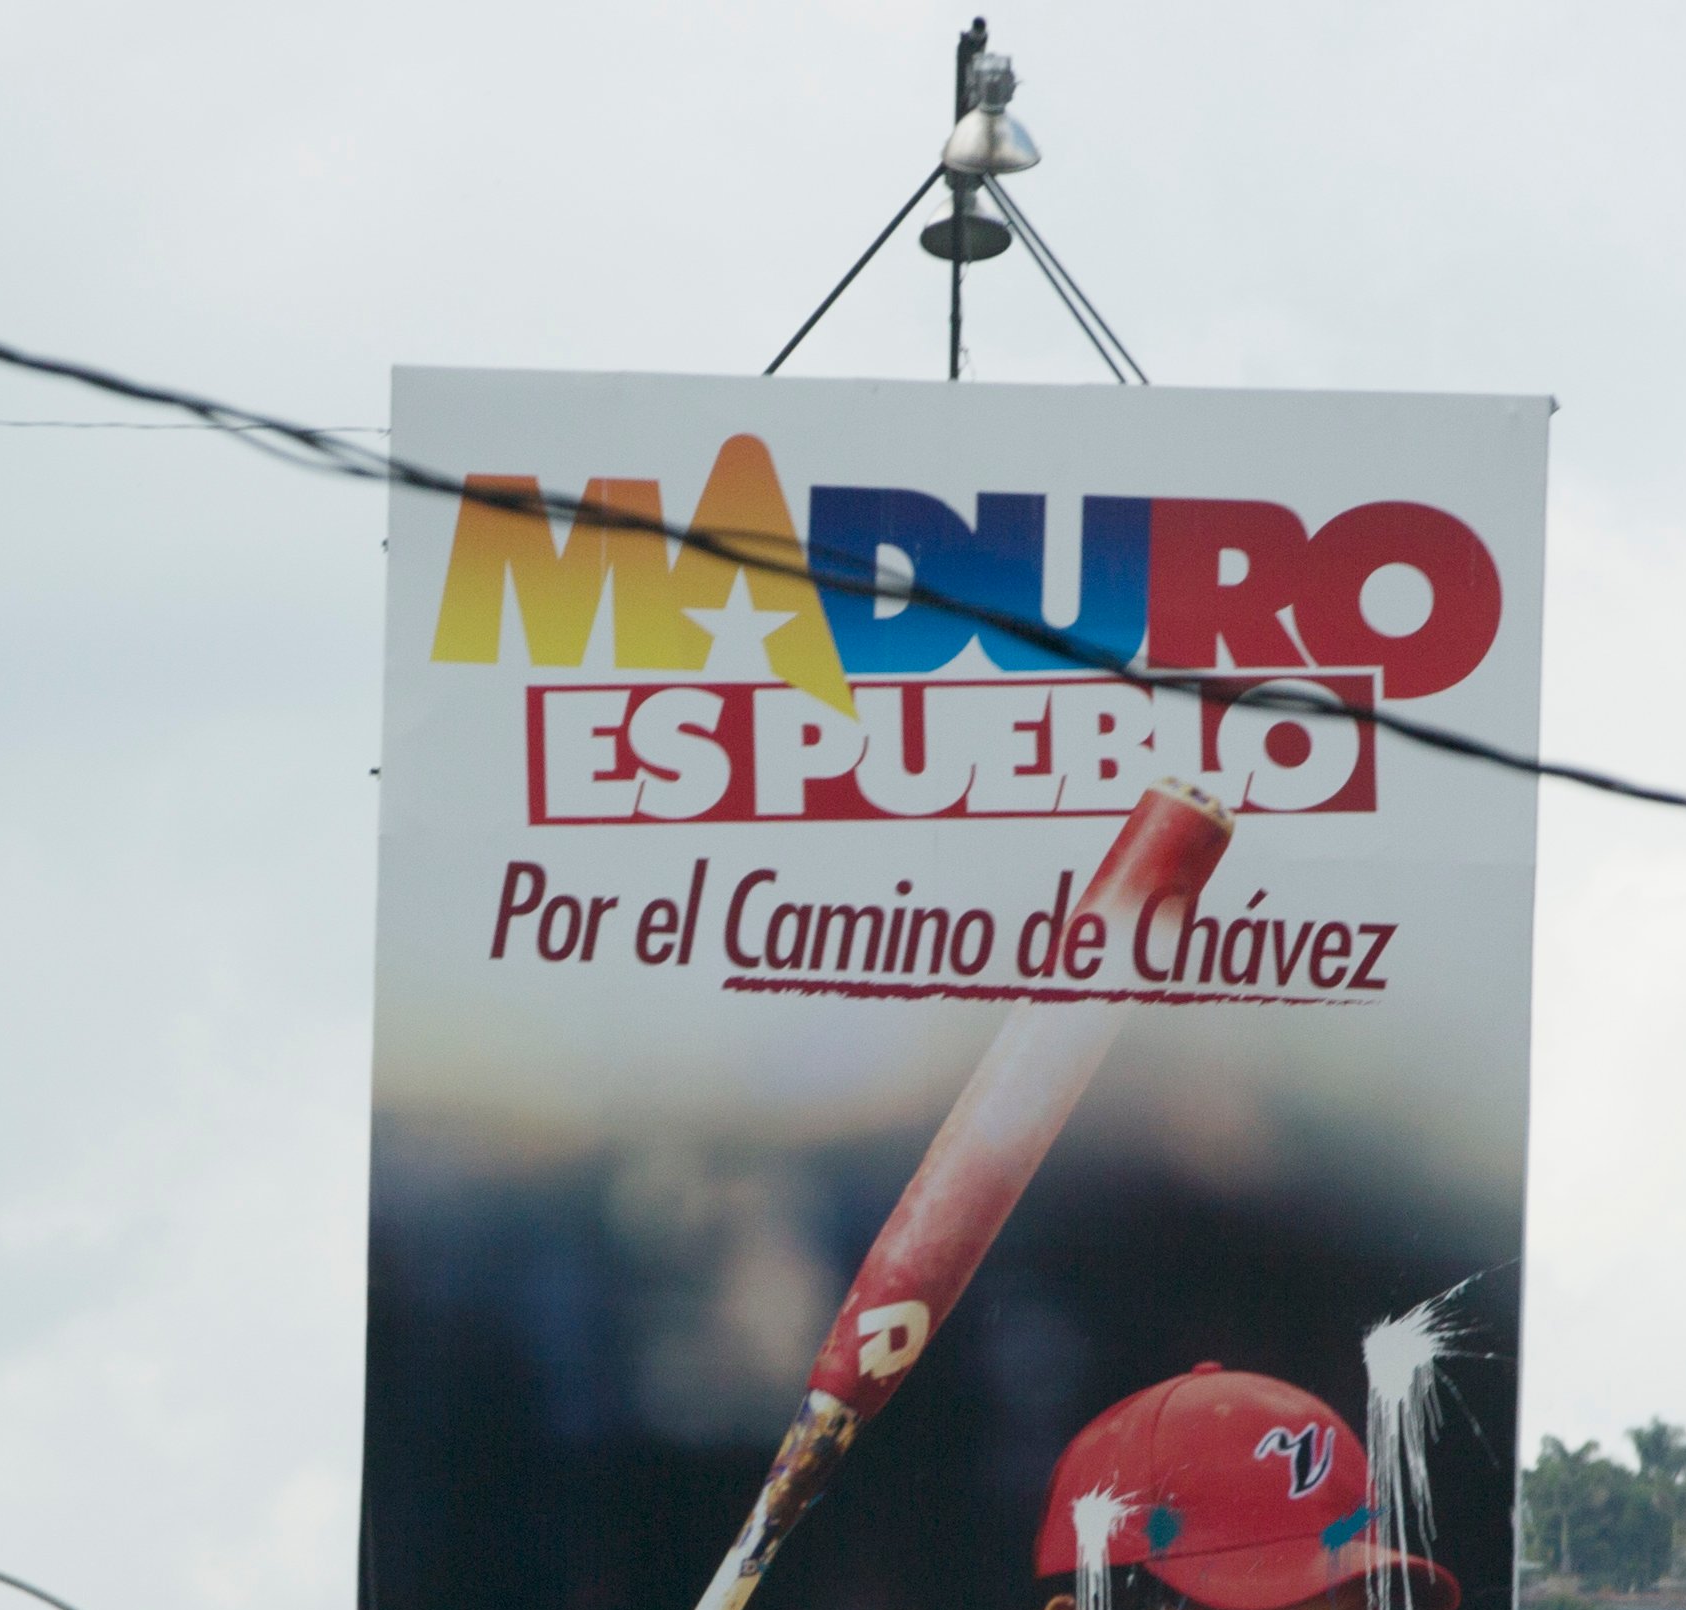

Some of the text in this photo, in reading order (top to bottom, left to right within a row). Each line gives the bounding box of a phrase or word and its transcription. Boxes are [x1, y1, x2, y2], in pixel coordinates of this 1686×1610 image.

[429, 433, 1503, 721] MADURO
[543, 678, 1361, 820] ES PUEBLO
[490, 858, 1399, 991] Por el Camino de Chávez
